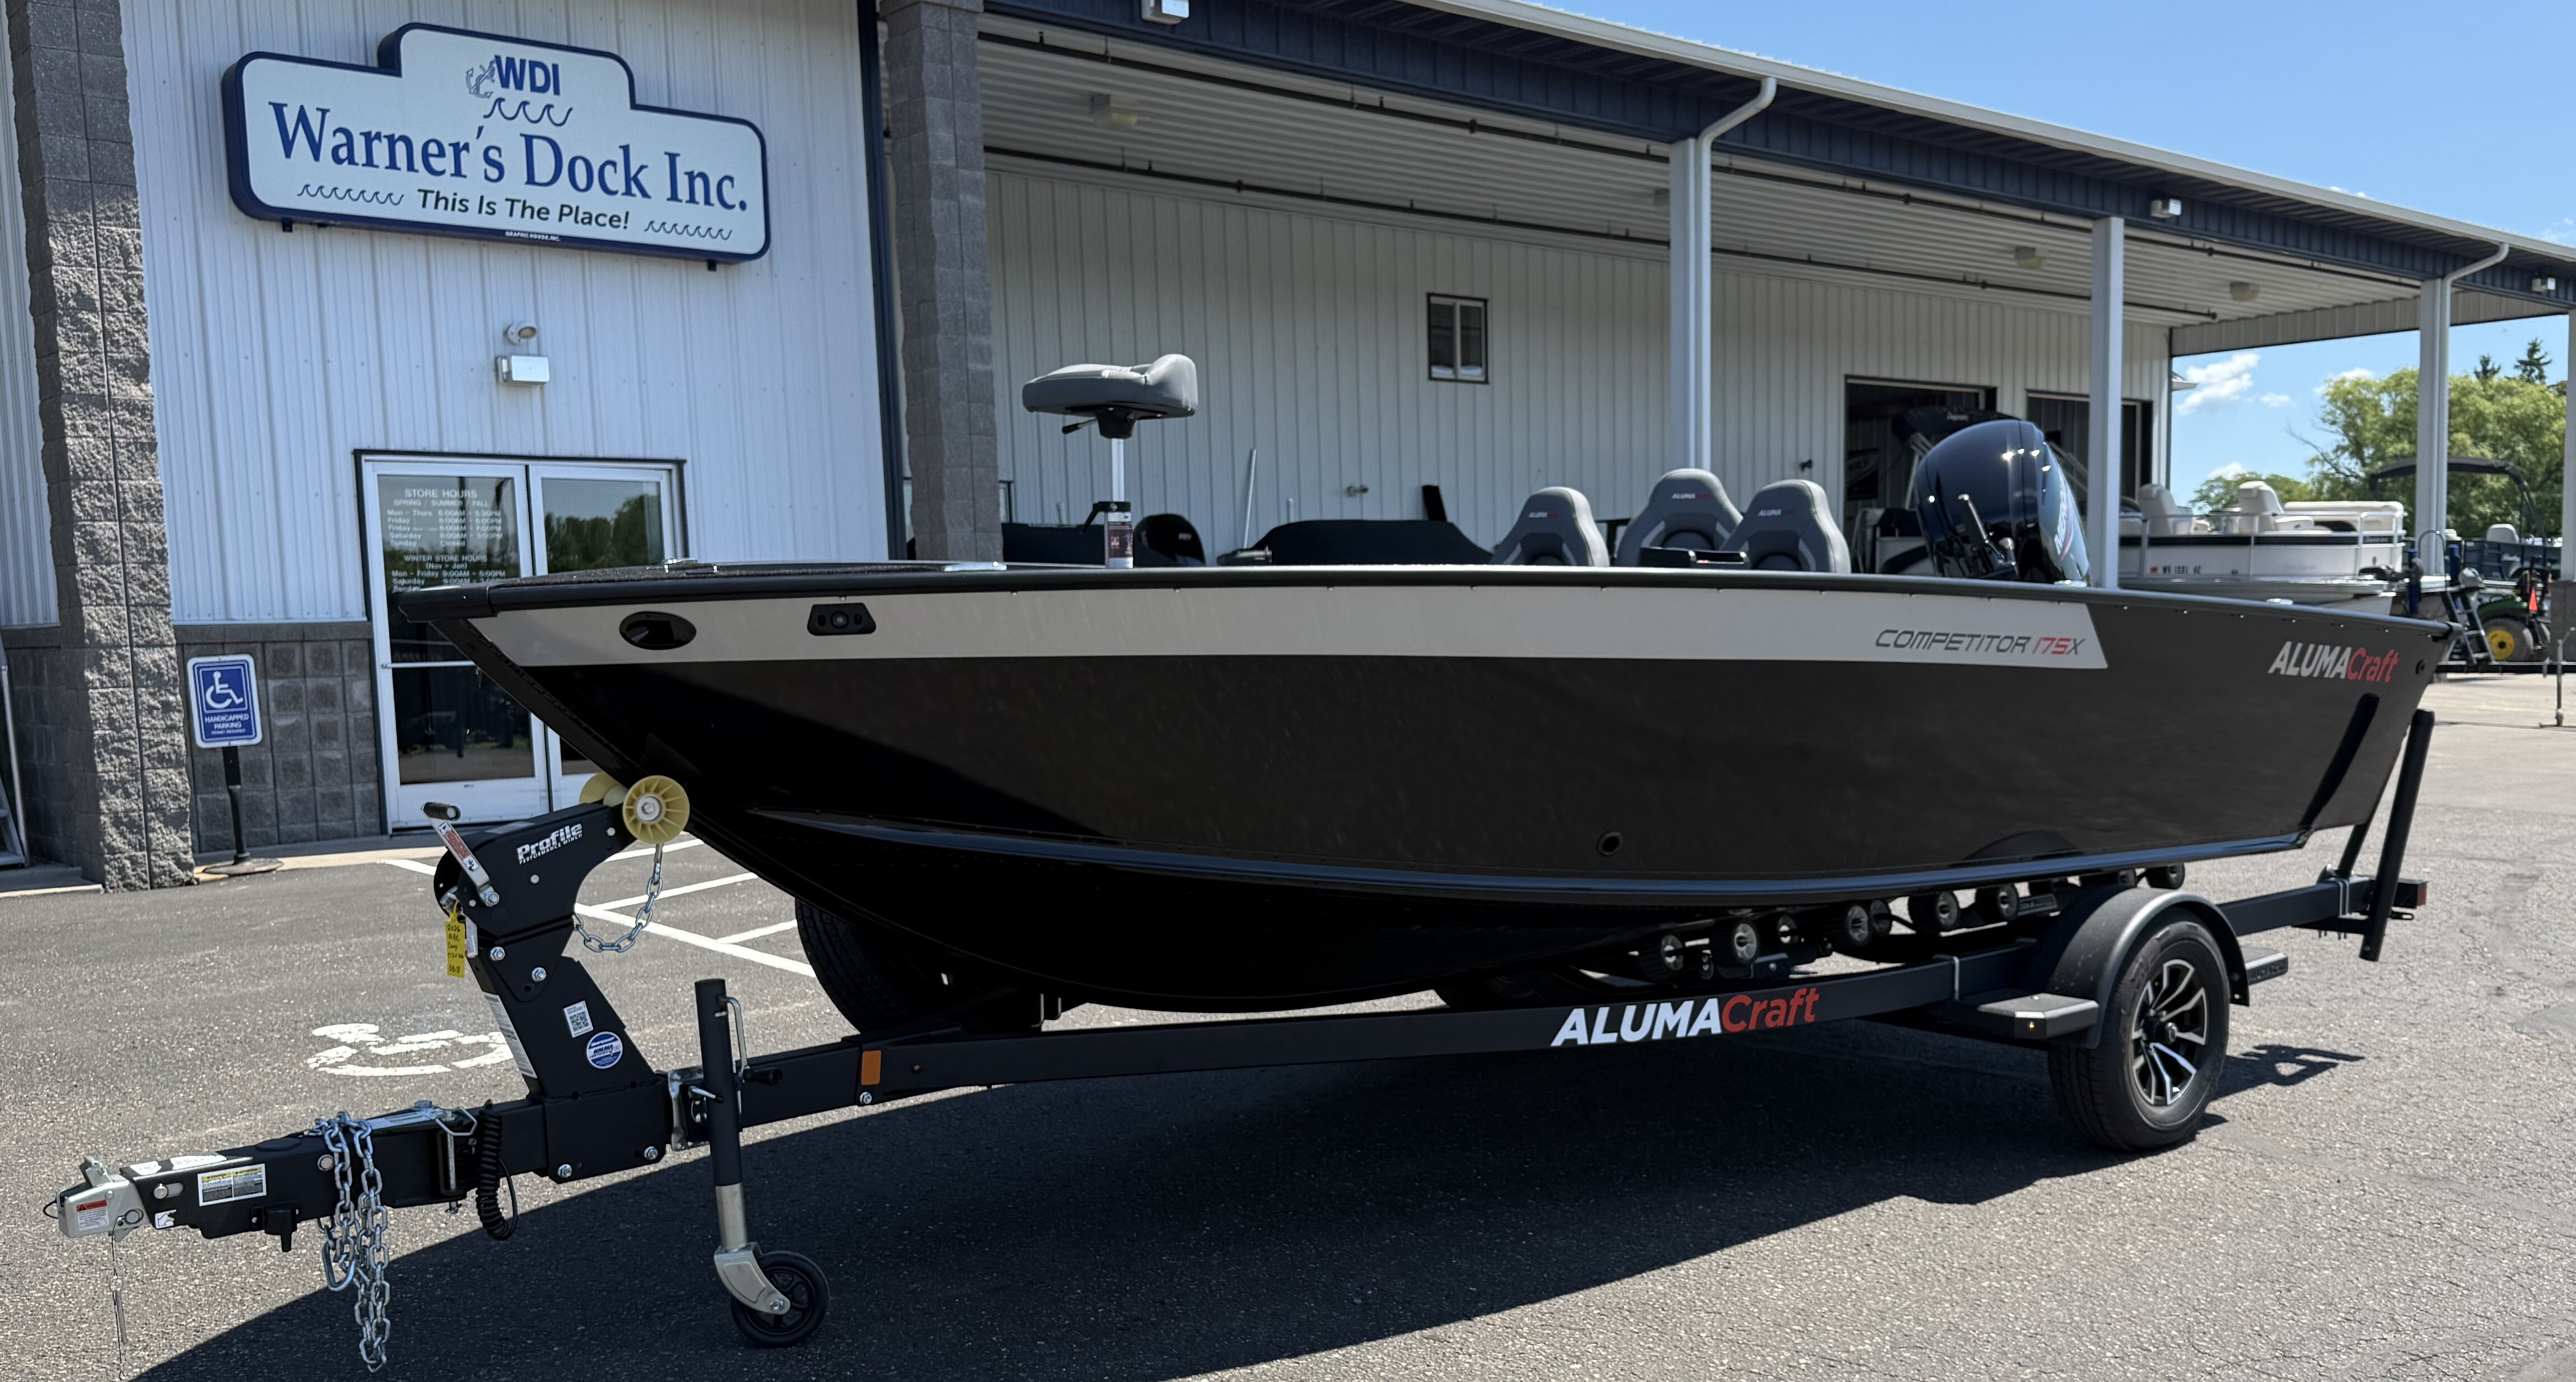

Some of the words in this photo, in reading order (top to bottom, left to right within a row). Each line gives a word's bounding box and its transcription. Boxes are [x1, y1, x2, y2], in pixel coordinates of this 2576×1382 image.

[494, 54, 561, 96] WDI
[268, 101, 505, 183] Warner's
[520, 133, 651, 199] Dock
[664, 151, 748, 212] Inc.
[417, 189, 469, 213] This
[478, 195, 497, 216] Is
[505, 198, 551, 221] The
[558, 204, 630, 230] Place!
[405, 488, 438, 498] STORE
[442, 489, 478, 499] HOURS
[417, 570, 439, 578] Friday
[1875, 629, 2031, 654] COMPETITOR
[2032, 636, 2085, 655] 175X
[2268, 640, 2400, 682] ALUMACraft
[205, 713, 249, 723] HANDICAPPED
[214, 721, 242, 729] PARKING
[517, 823, 582, 861] Profile
[1551, 987, 1819, 1047] ALUMACraft
